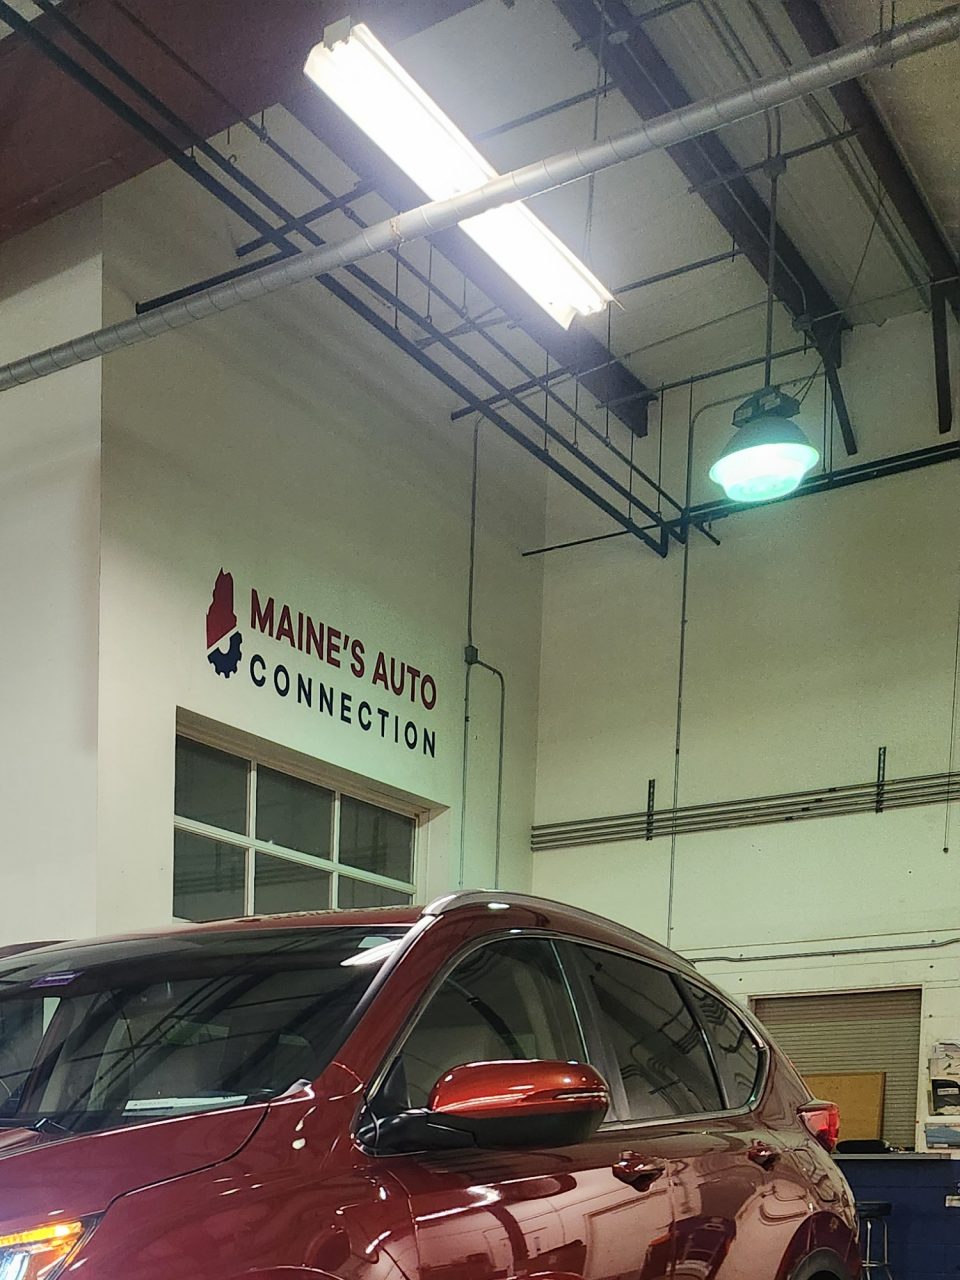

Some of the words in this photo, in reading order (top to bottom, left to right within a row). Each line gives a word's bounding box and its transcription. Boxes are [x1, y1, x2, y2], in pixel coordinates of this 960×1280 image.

[250, 588, 365, 678] MAINE'S
[372, 652, 437, 710] AUTO
[250, 654, 436, 758] CONNECTION
